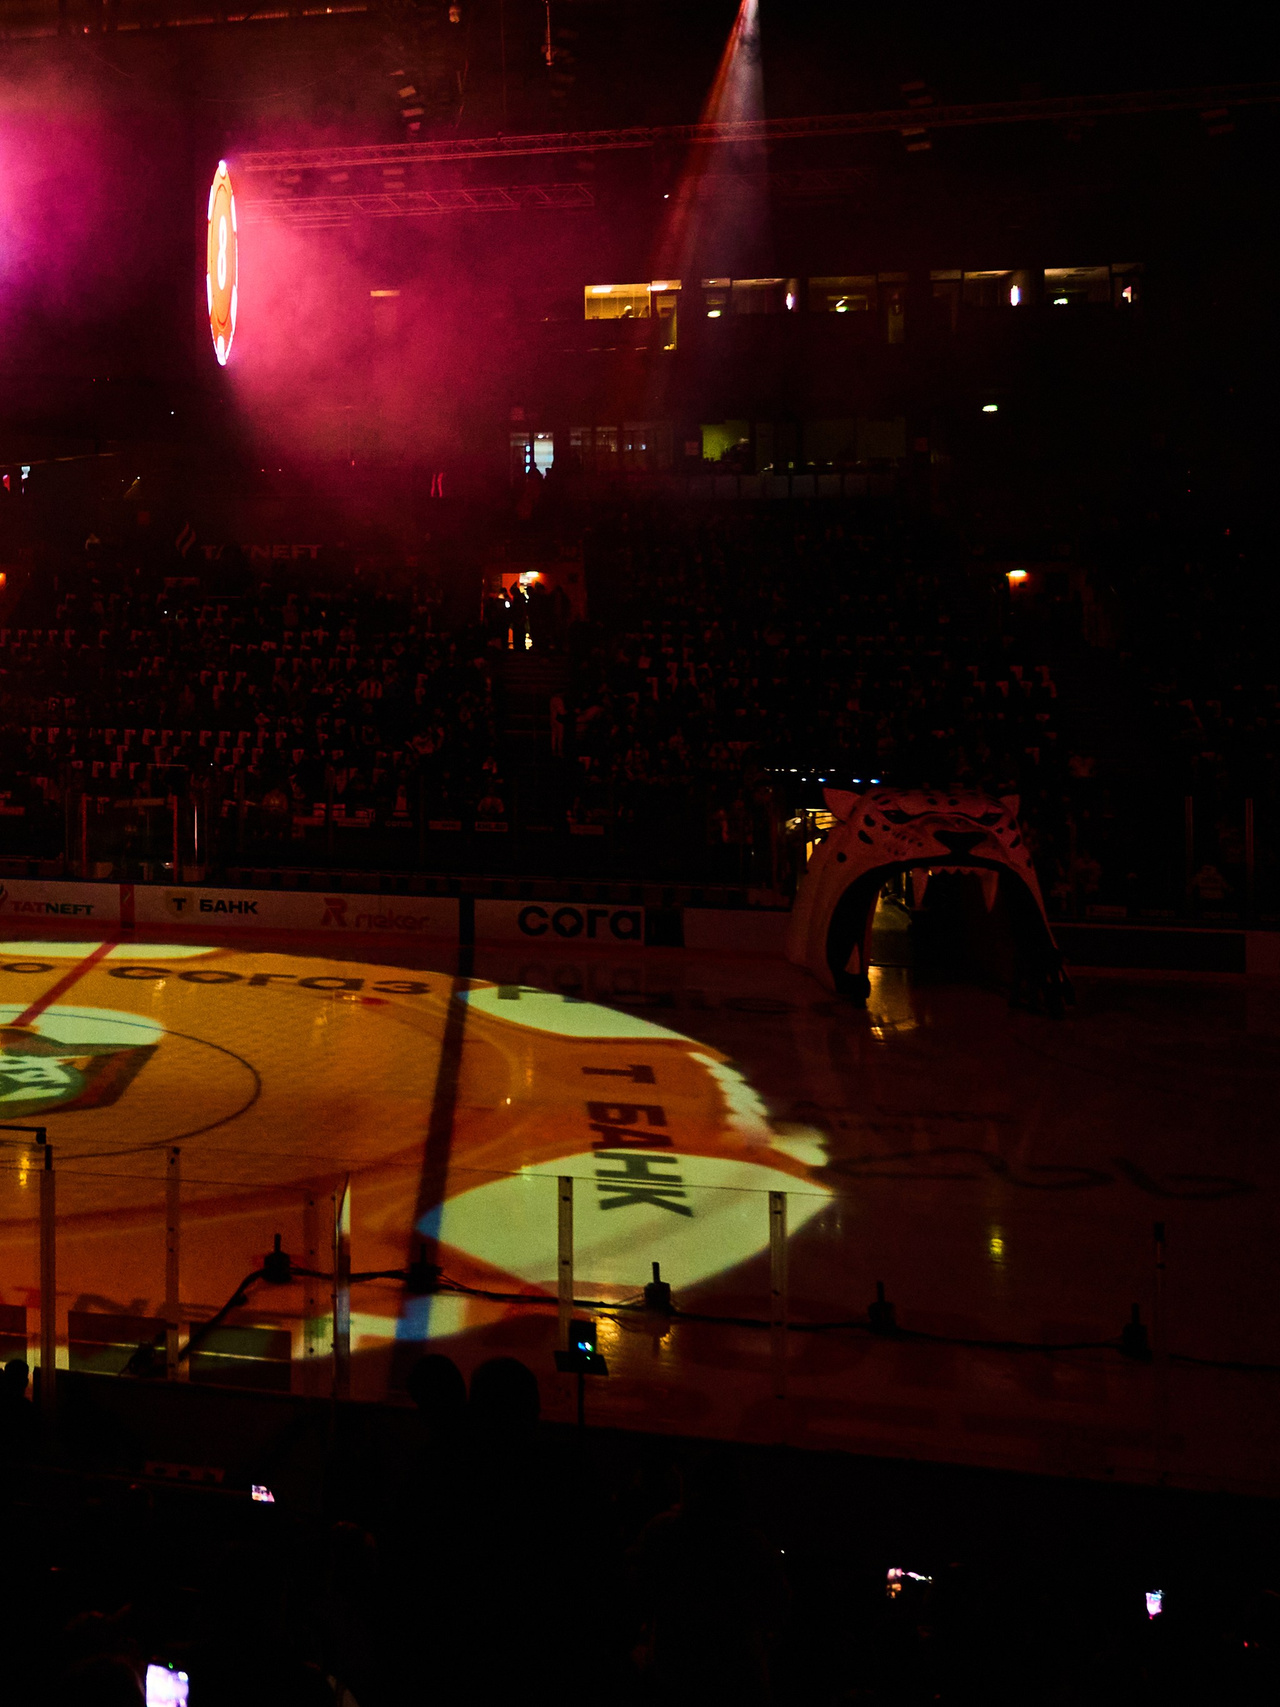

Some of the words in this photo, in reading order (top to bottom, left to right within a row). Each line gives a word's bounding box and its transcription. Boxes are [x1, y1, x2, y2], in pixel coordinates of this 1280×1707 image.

[200, 544, 323, 561] TNEFT
[11, 900, 94, 916] TATNEFT
[200, 898, 259, 915] БАНК
[518, 906, 642, 940] сога
[589, 1102, 694, 1220] БАНК
